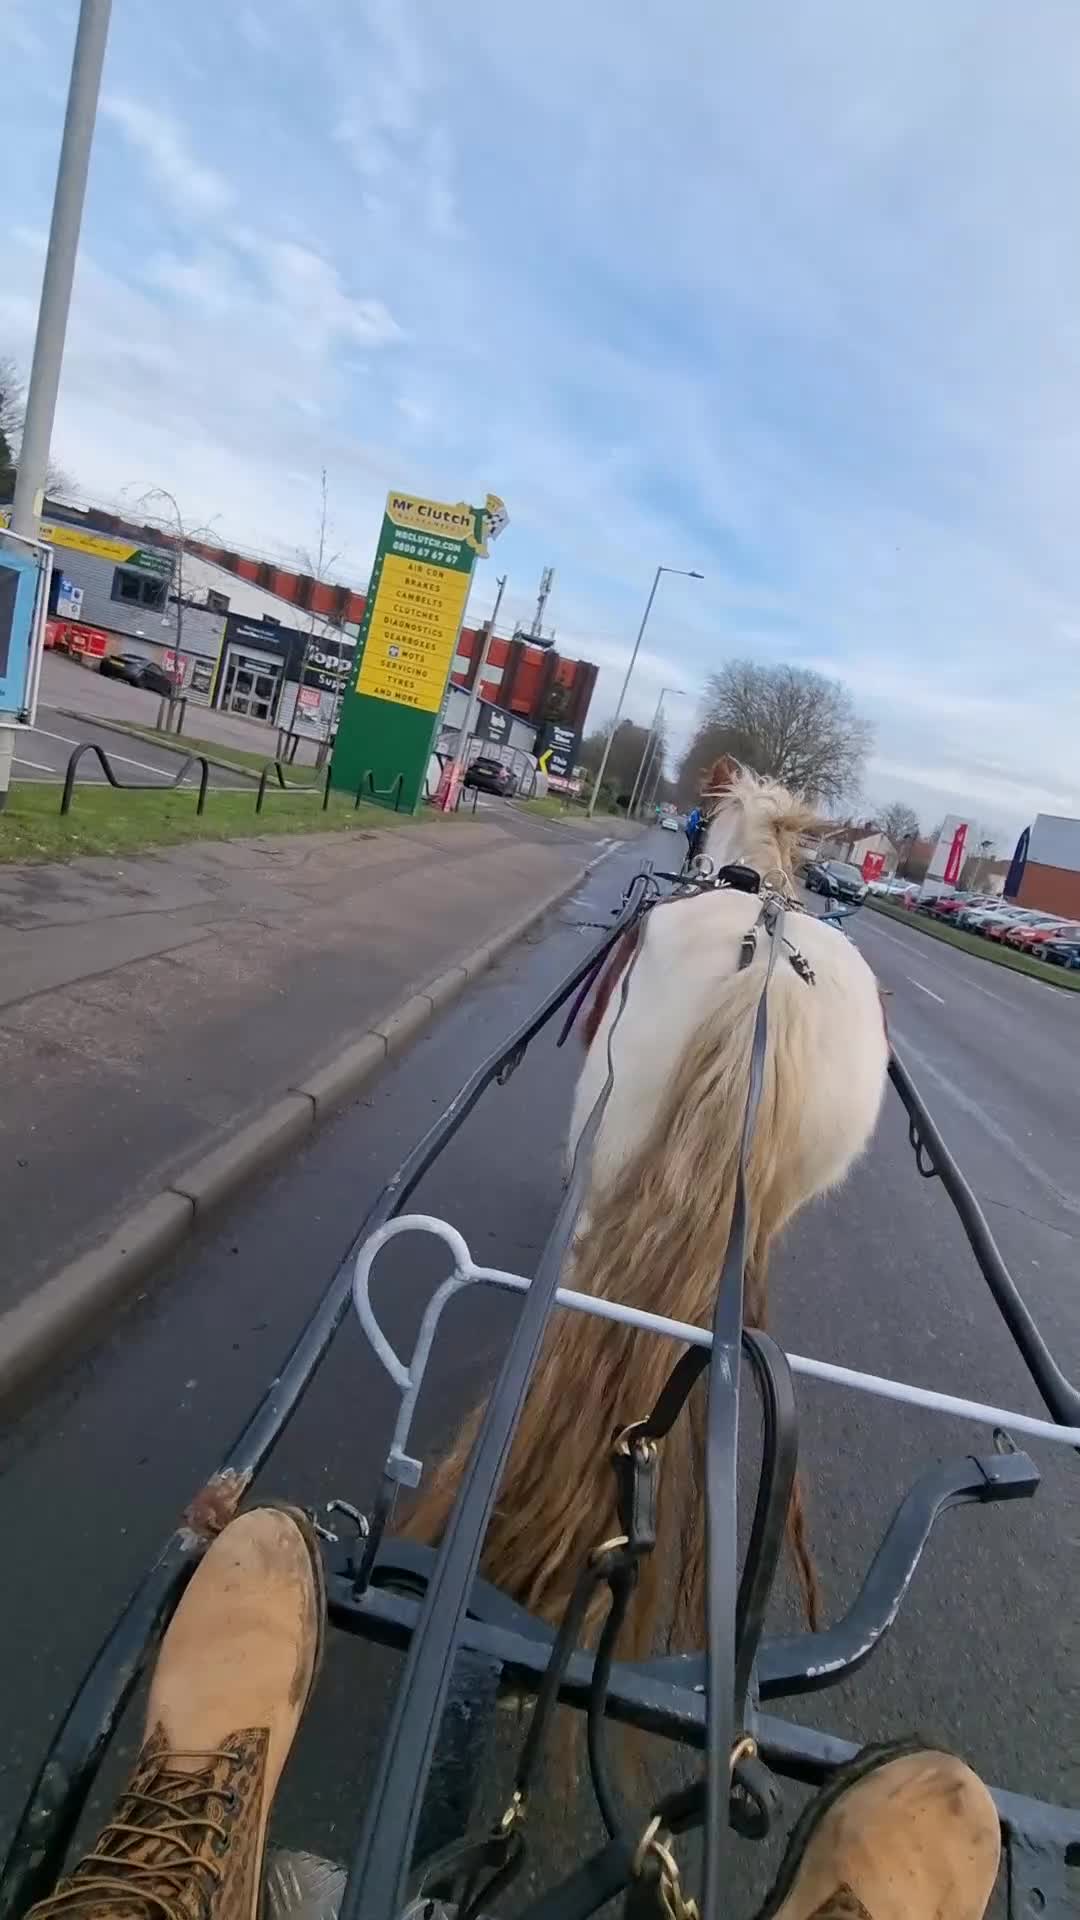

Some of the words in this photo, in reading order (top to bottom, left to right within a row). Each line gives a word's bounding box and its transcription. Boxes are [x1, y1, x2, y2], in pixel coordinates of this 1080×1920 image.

[392, 498, 414, 510] Mr
[417, 505, 470, 526] Clutch
[392, 541, 416, 554] 0800
[417, 547, 430, 557] 67
[431, 551, 445, 560] 67
[445, 554, 458, 564] 67
[408, 564, 423, 573] AIR
[426, 568, 444, 578] CON
[404, 577, 441, 592] BRAKES
[396, 590, 443, 608] CAMBELTS
[393, 604, 440, 622] CLUTCHES
[383, 616, 443, 638] DIAGNOSTICS
[384, 631, 437, 651] GEARBOXES
[381, 659, 428, 678] SERVICING
[387, 675, 415, 688] TYRES
[374, 687, 392, 697] AND
[395, 692, 419, 704] MORE
